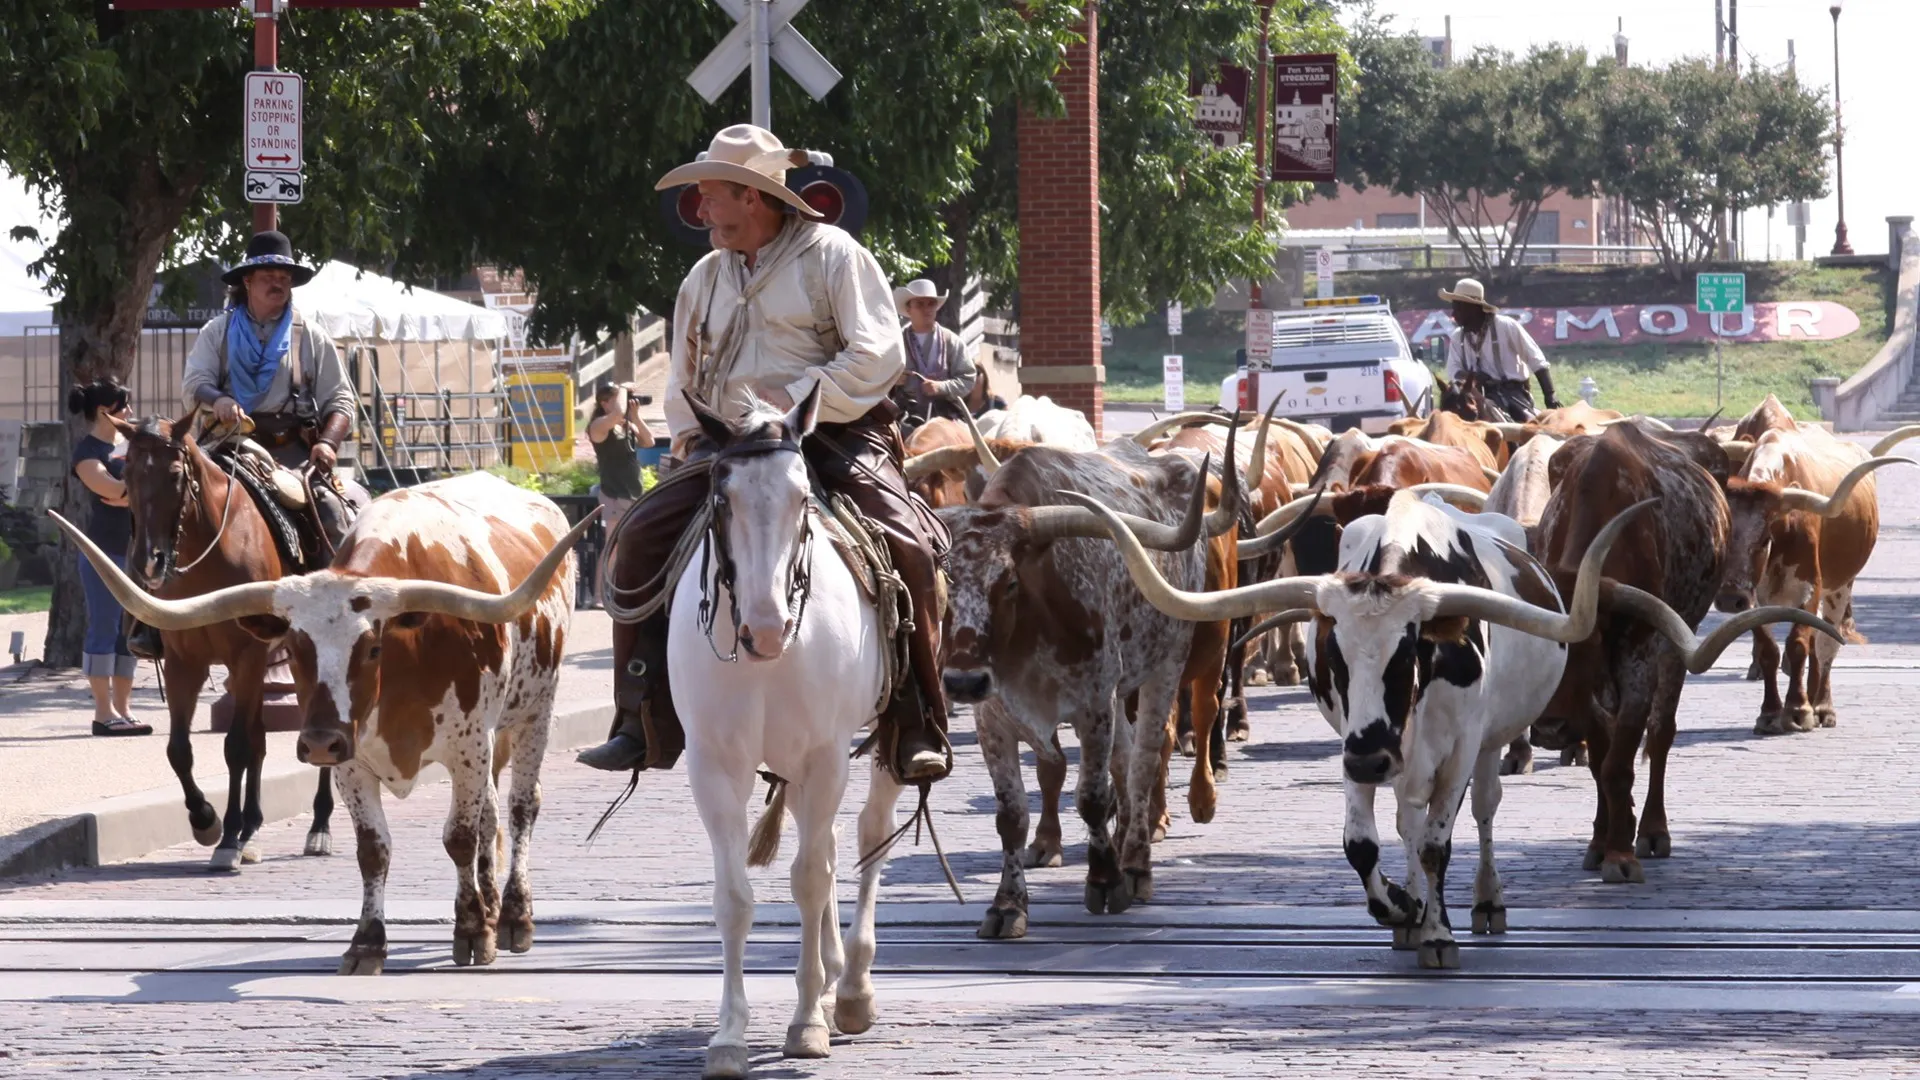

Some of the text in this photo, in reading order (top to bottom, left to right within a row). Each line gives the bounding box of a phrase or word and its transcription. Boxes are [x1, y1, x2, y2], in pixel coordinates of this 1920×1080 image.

[1280, 74, 1330, 82] STOCKYARDS
[264, 81, 284, 95] NO
[253, 98, 293, 110] PARKING
[251, 111, 296, 124] STOPPING
[267, 125, 279, 136] OR
[250, 139, 296, 150] STANDING
[1700, 276, 1709, 284] TO
[1722, 276, 1741, 284] MAIN
[1360, 367, 1379, 376] 218
[1273, 395, 1363, 409] OLICE
